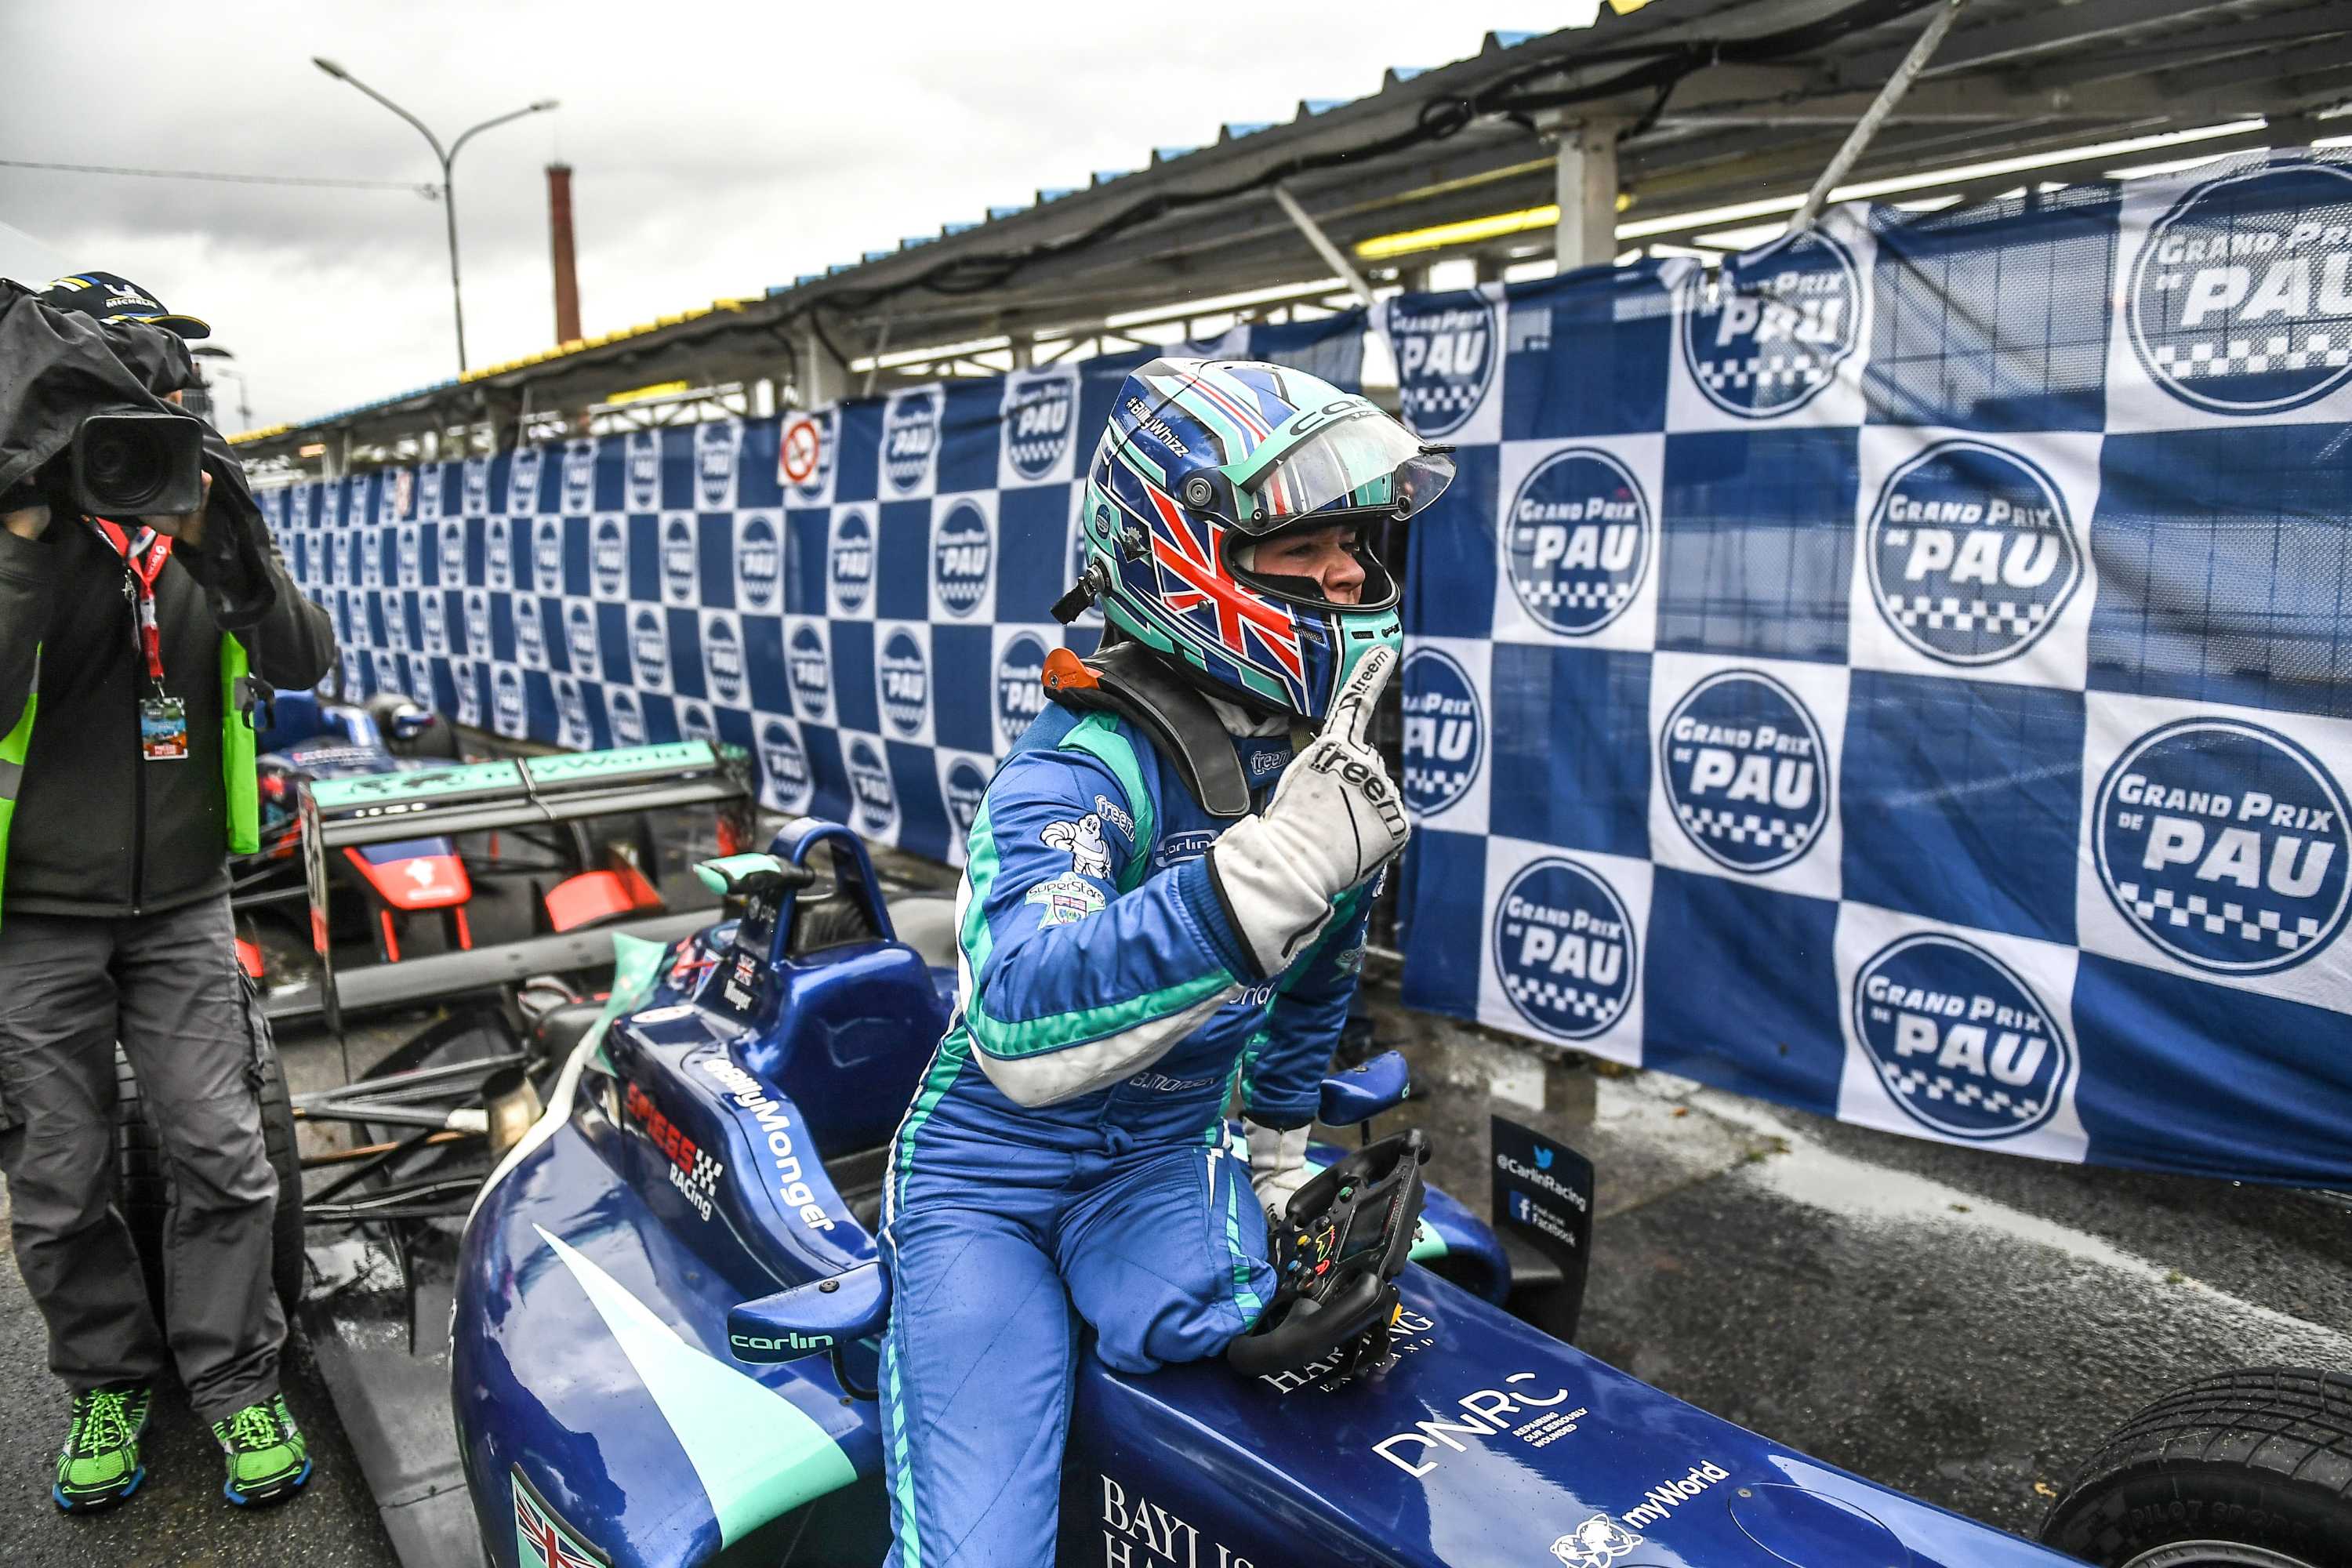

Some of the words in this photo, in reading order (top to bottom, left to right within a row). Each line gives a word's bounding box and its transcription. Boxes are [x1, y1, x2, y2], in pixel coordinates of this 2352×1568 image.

[2158, 232, 2279, 264] GRAND
[2285, 222, 2352, 250] PR
[1402, 331, 1486, 381] PAU
[1018, 398, 1068, 437] PAU
[1126, 396, 1191, 459] #BillyWhizz
[1518, 498, 1582, 522] GRAND
[1584, 497, 1638, 521] PRIX
[1889, 495, 1984, 522] GRAND
[1987, 499, 2053, 527] PRIX
[942, 546, 989, 576] PAU
[1534, 524, 1639, 571] PAU
[1905, 530, 2060, 587] PAU
[1351, 650, 1388, 693] freem
[1007, 681, 1043, 713] PA
[1674, 716, 1750, 750] GRAND
[1754, 726, 1811, 754] PRIX
[1311, 742, 1407, 837] freem
[1690, 750, 1814, 809] PAU
[2118, 773, 2233, 819] GRAND
[2238, 791, 2334, 833] PRIX
[2118, 812, 2143, 830] DE
[2142, 815, 2336, 898] PAU
[1507, 895, 1570, 927] GRAND
[1569, 909, 1622, 940] PRIX
[1519, 925, 1624, 985] PAU
[1866, 975, 1965, 1018] GRAND
[1968, 995, 2041, 1033] PRIX
[1893, 1014, 2047, 1086] PAU
[731, 1332, 834, 1350] carlin
[1371, 1372, 1569, 1479] DNRC
[1512, 1412, 1559, 1438] REPAIRING
[1523, 1429, 1547, 1443] OUR
[1543, 1407, 1588, 1434] SERIOUSLY
[1532, 1424, 1577, 1448] WOUNDED
[1621, 1460, 1731, 1530] myWorld
[2129, 1499, 2203, 1526] PILOT
